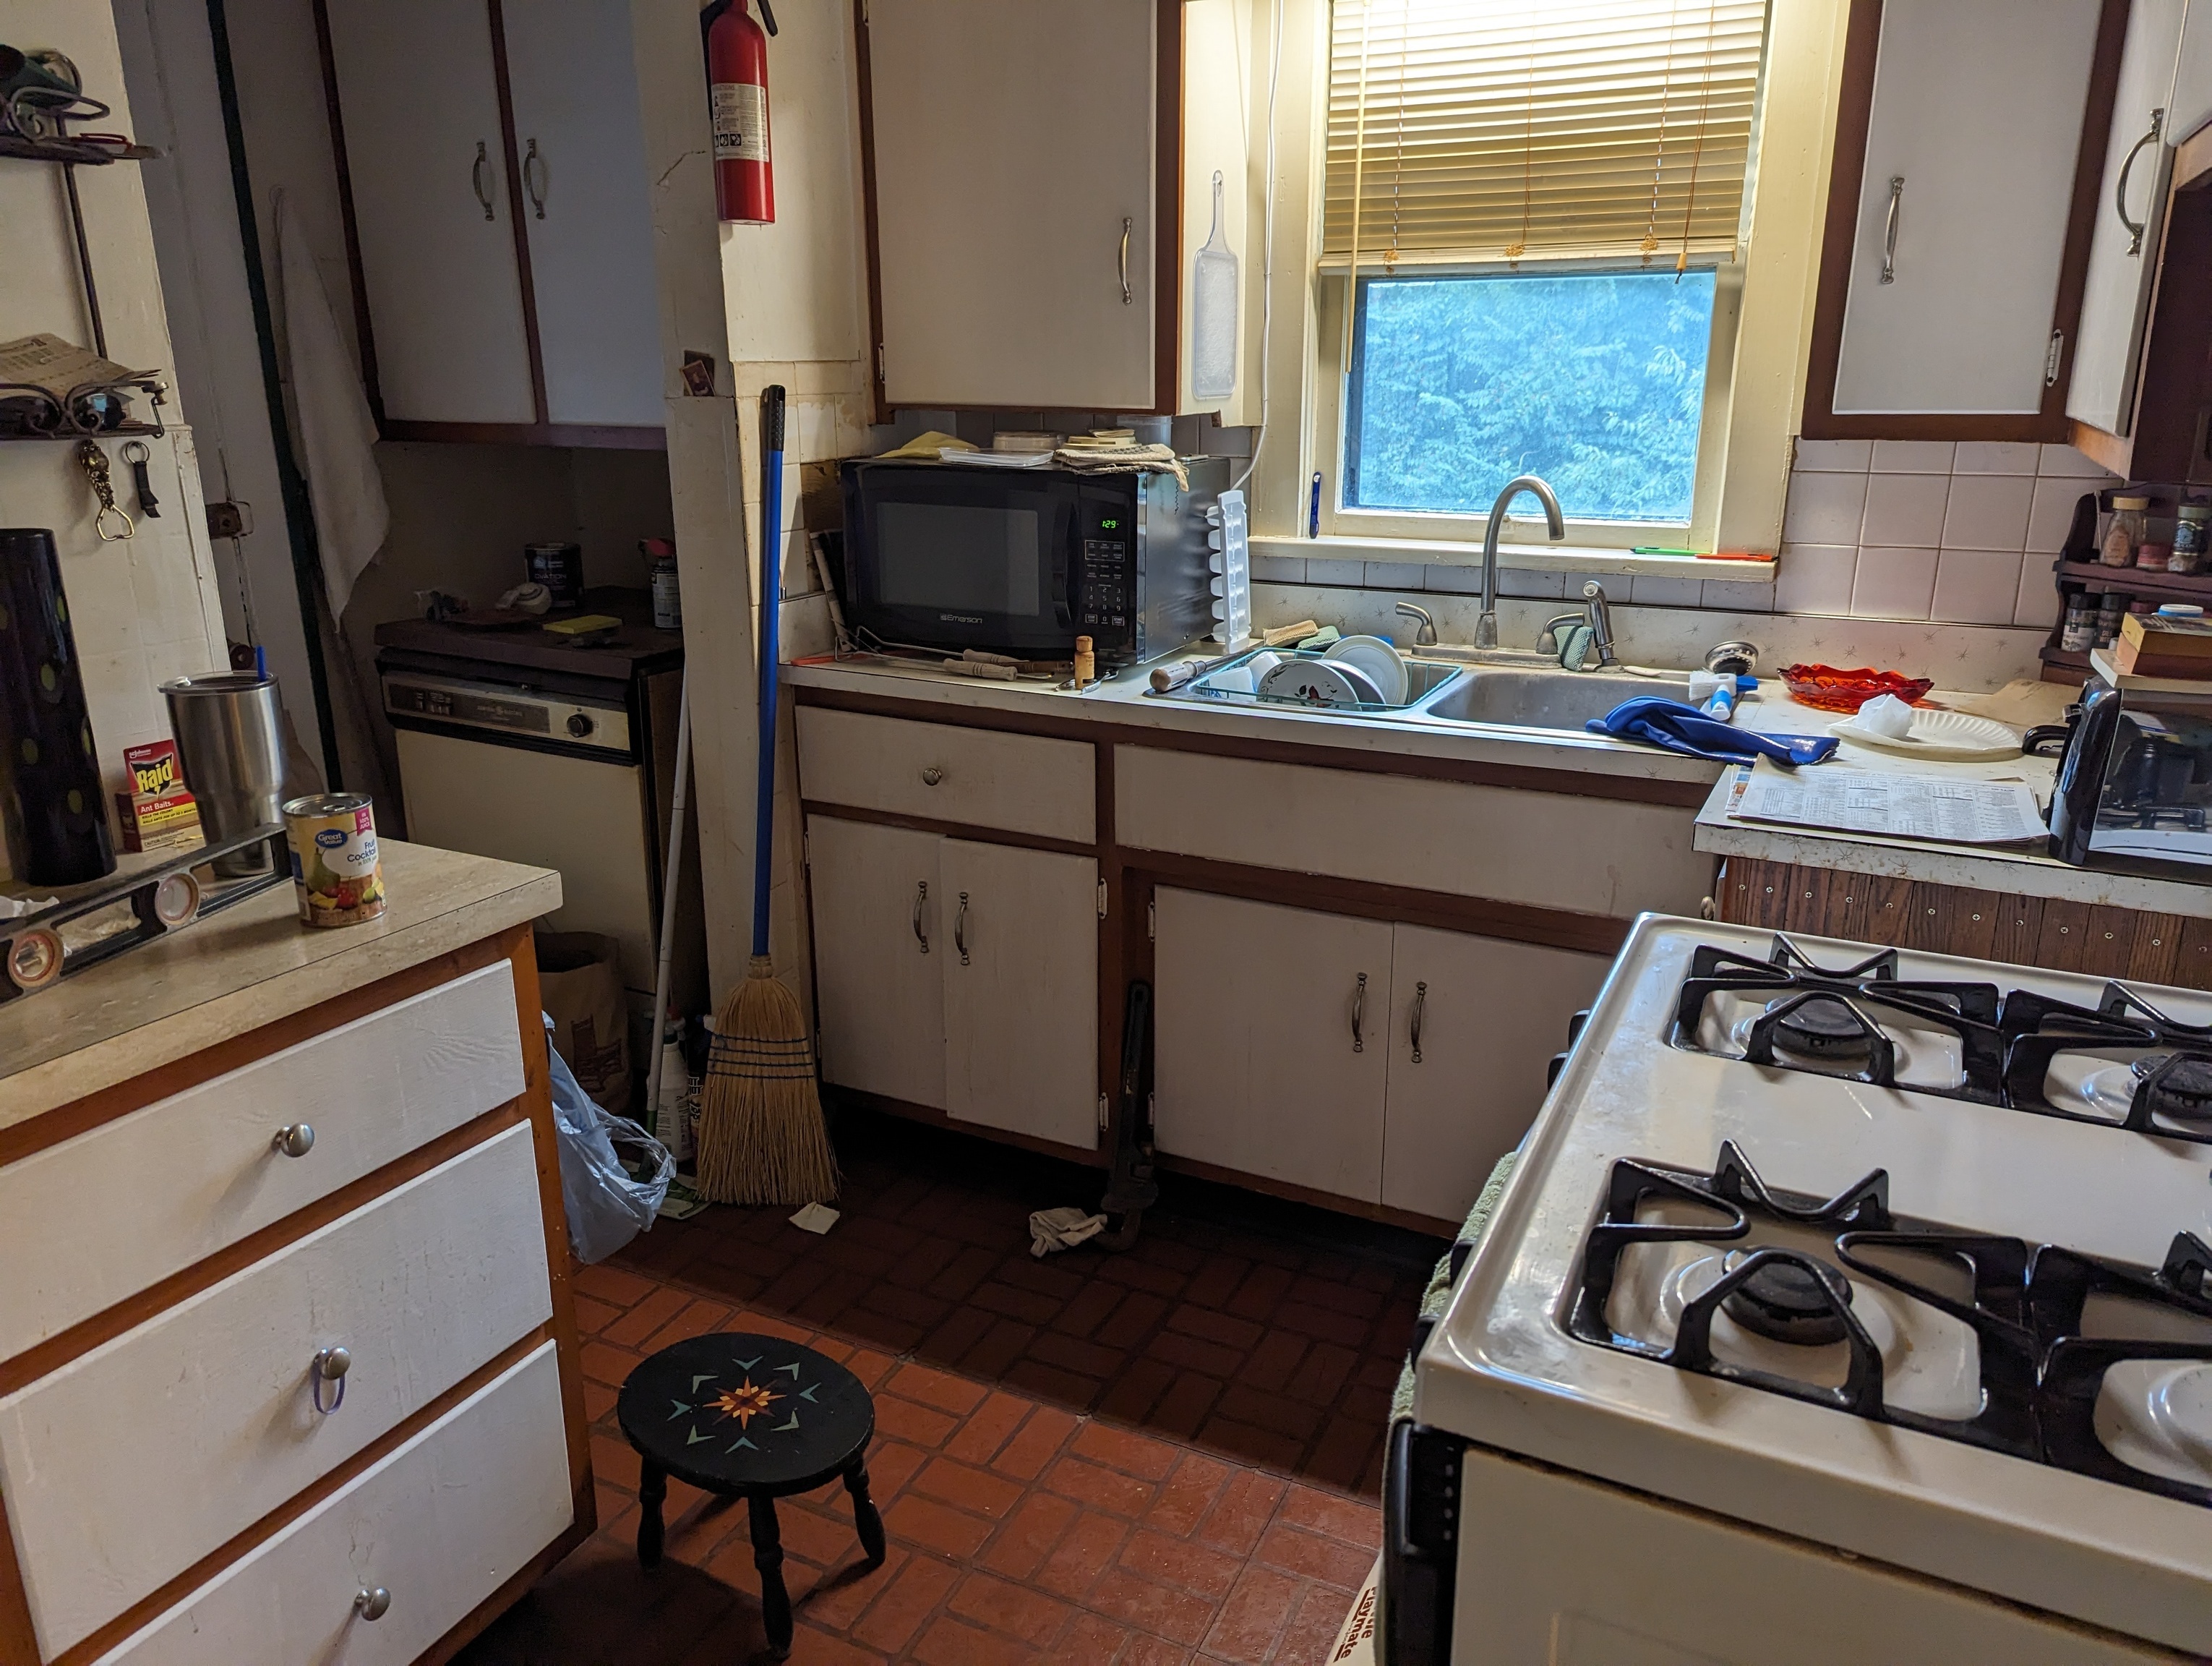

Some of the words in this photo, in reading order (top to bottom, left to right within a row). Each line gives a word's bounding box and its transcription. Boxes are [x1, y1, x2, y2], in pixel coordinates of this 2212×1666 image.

[1102, 520, 1116, 529] 1:29
[947, 614, 982, 624] Emerson
[136, 759, 173, 793] Raid
[140, 805, 153, 813] Ant
[154, 800, 171, 811] Baits
[318, 832, 342, 842] Great
